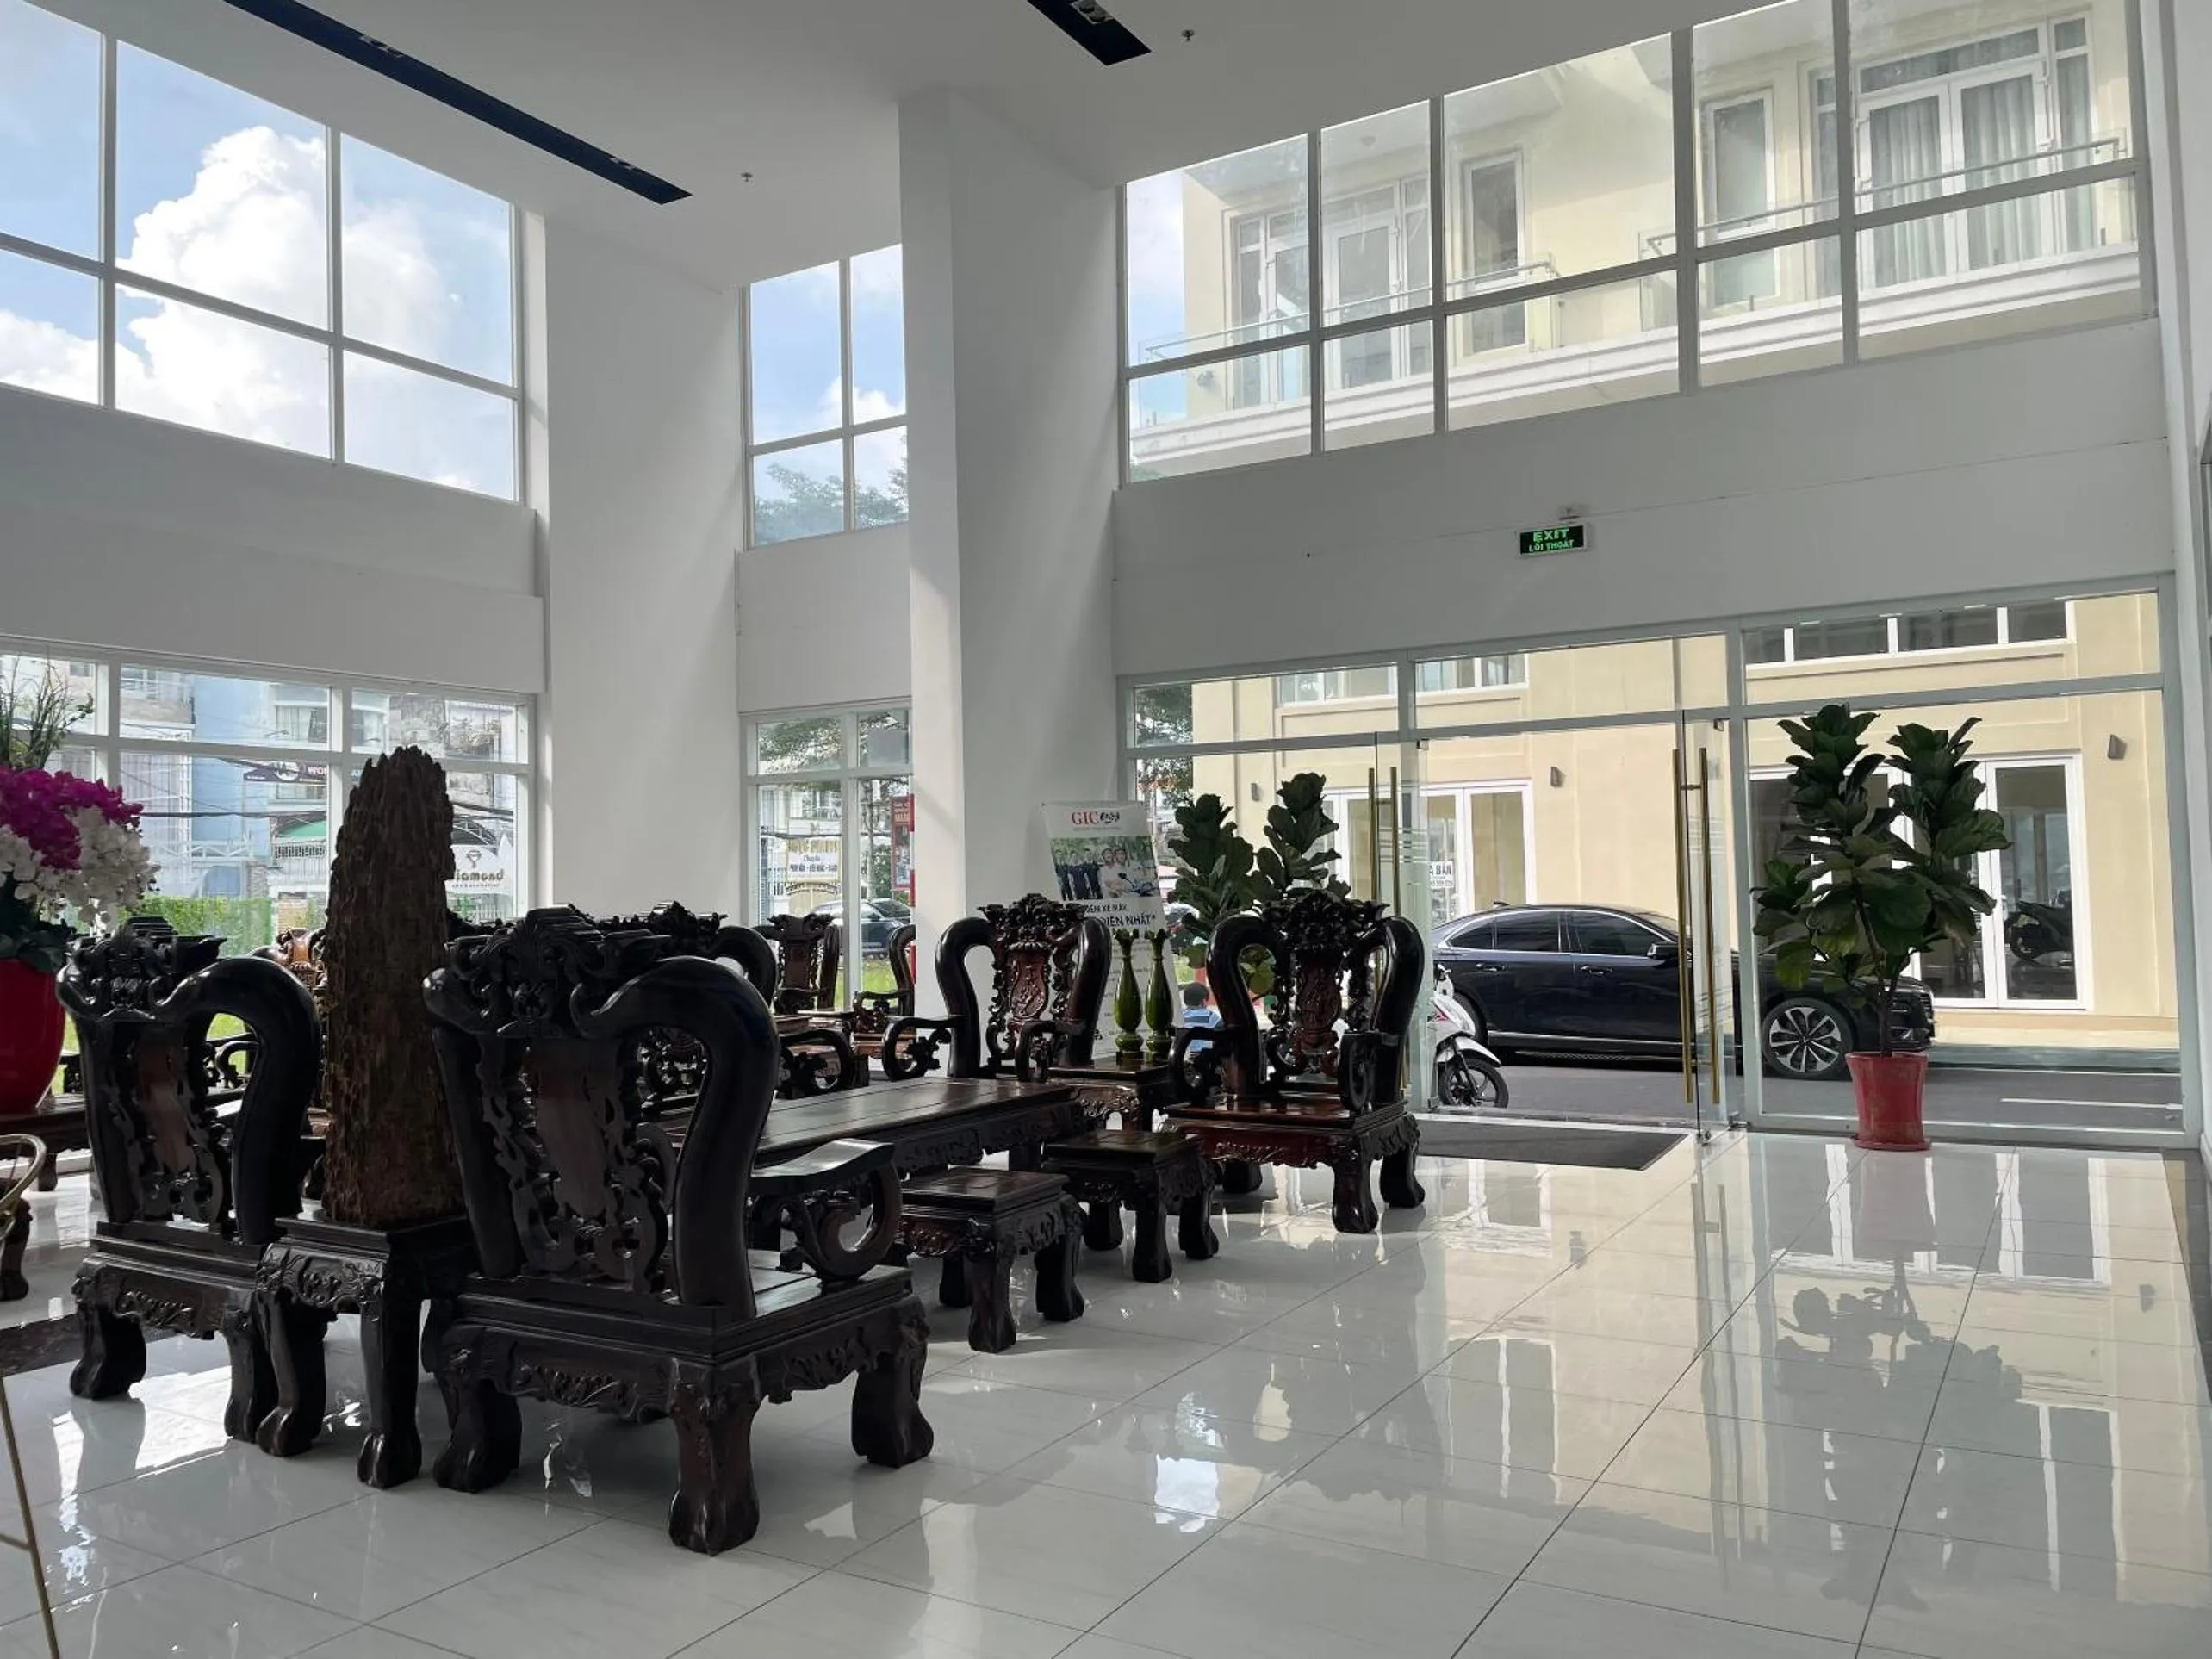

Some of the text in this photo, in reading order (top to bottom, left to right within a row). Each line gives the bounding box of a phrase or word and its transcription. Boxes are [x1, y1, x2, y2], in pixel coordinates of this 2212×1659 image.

[1533, 528, 1569, 542] EXIT
[1071, 811, 1100, 825] GIC
[457, 867, 505, 881] iamond
